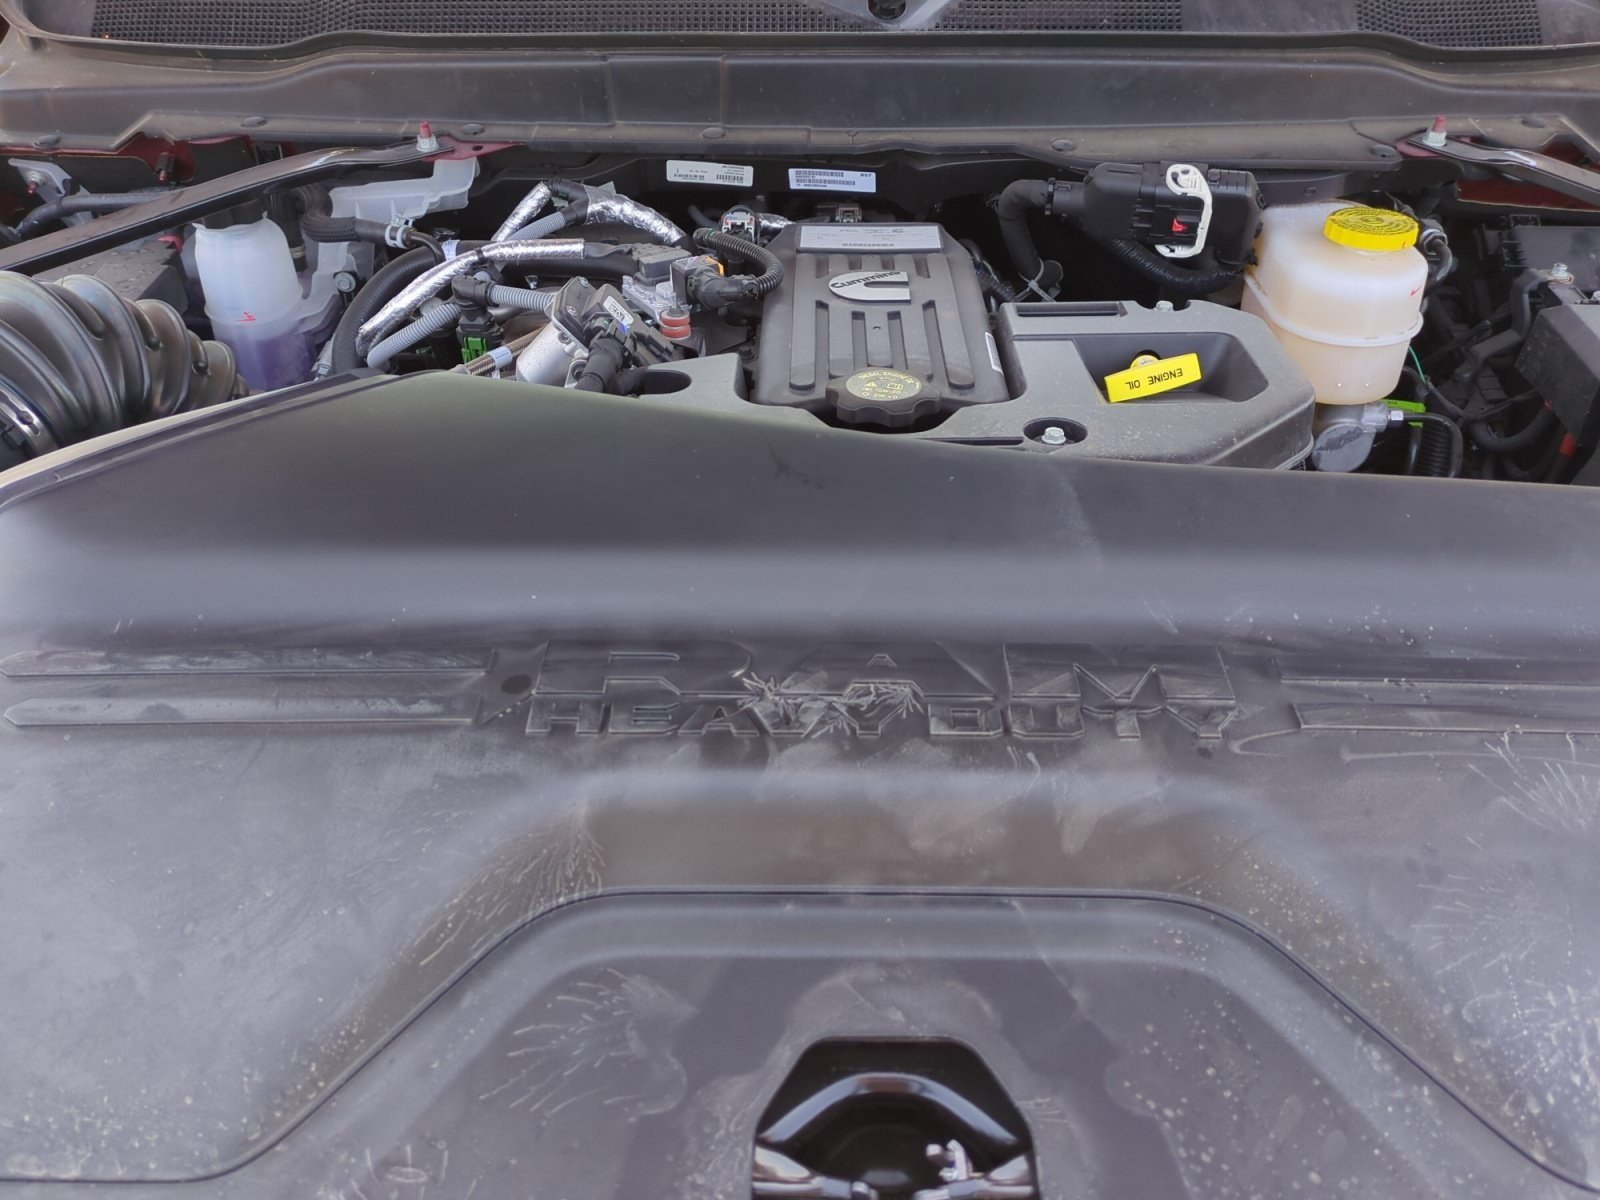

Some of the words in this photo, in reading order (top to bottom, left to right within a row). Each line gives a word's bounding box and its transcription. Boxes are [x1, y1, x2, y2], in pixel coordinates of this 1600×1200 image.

[830, 271, 901, 289] Cummins
[1125, 379, 1141, 390] OIL
[1147, 368, 1184, 386] ENGINE
[525, 700, 912, 738] HEAVY
[928, 700, 1241, 742] DUTY
